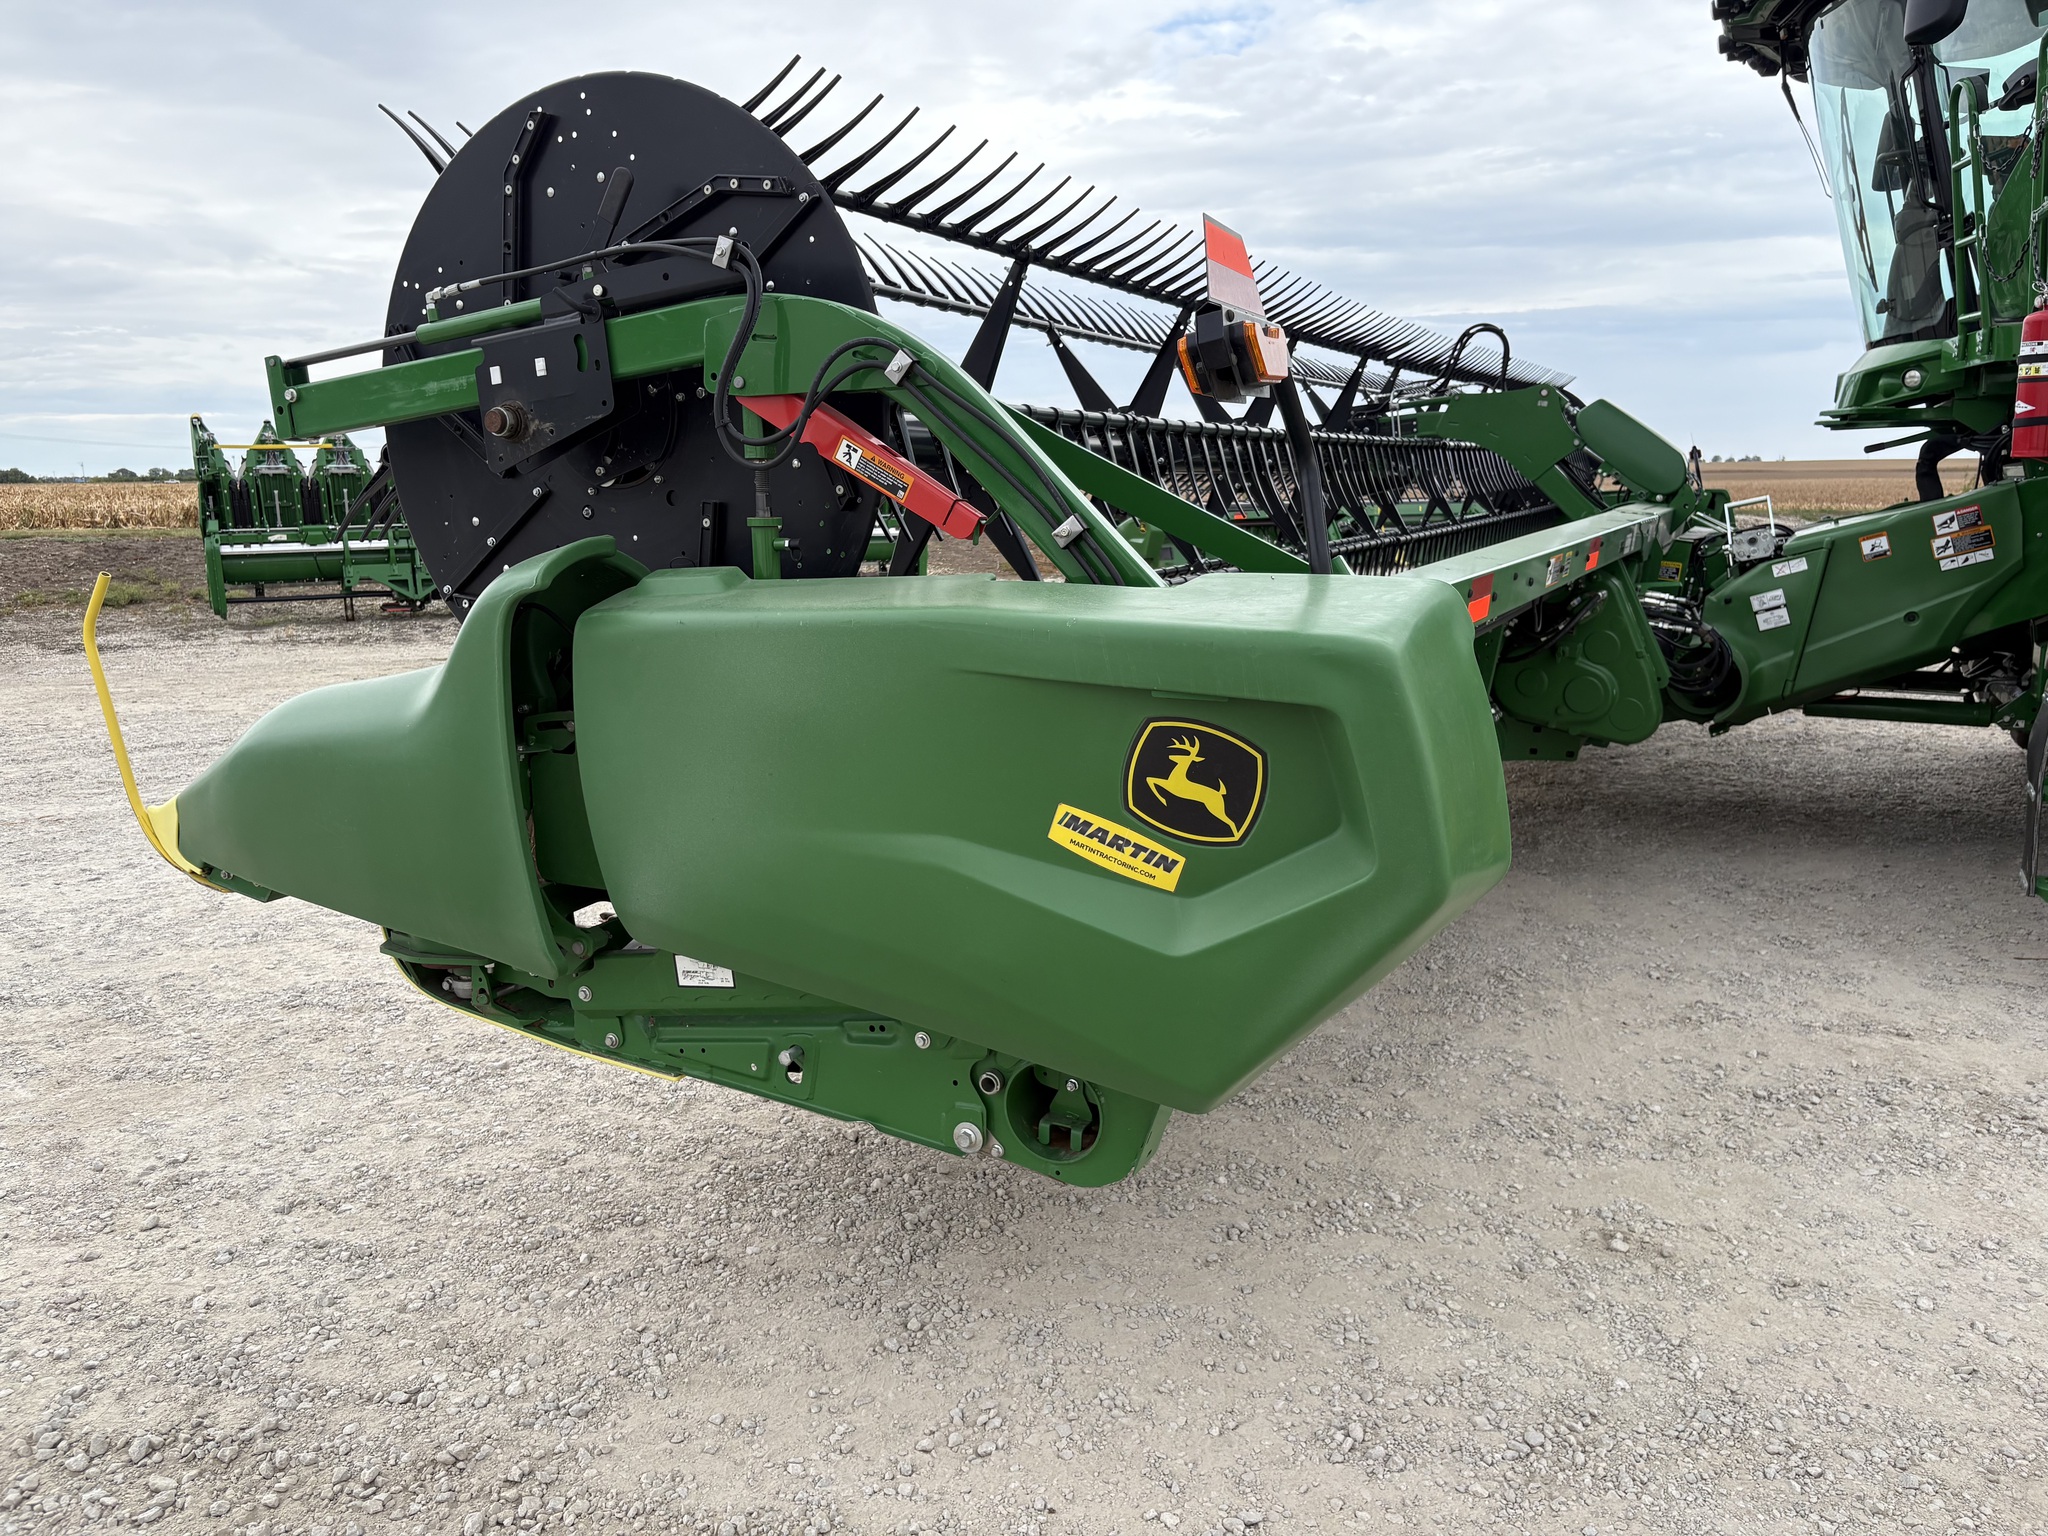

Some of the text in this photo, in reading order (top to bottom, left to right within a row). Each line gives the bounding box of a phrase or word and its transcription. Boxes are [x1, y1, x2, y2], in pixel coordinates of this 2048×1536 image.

[877, 459, 905, 479] WARNING
[1063, 813, 1180, 874] MARTIN
[1069, 838, 1157, 881] MARTINTRACTORINC.COM
